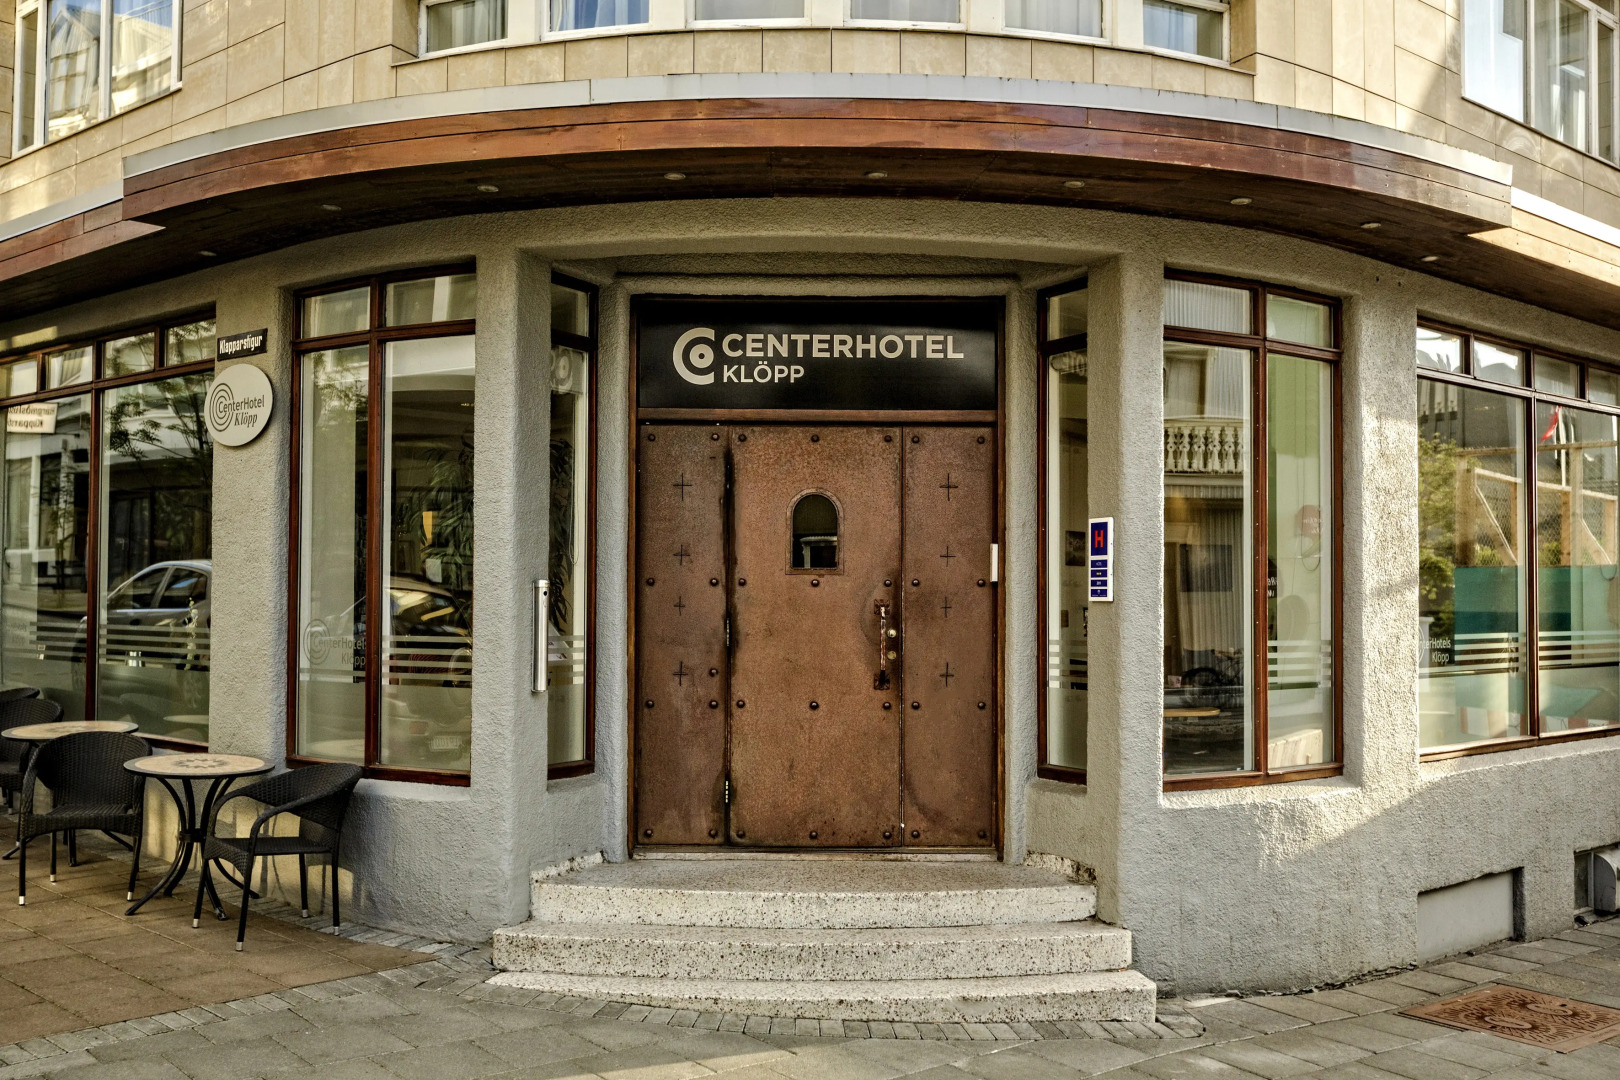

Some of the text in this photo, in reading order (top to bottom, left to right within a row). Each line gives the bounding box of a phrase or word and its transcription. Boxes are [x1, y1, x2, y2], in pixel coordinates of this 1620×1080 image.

[721, 333, 965, 359] CENTERHOTEL
[723, 361, 805, 383] KLÖPP
[219, 395, 265, 414] CenterHotel
[234, 412, 258, 428] Klöpp
[1094, 530, 1104, 549] H
